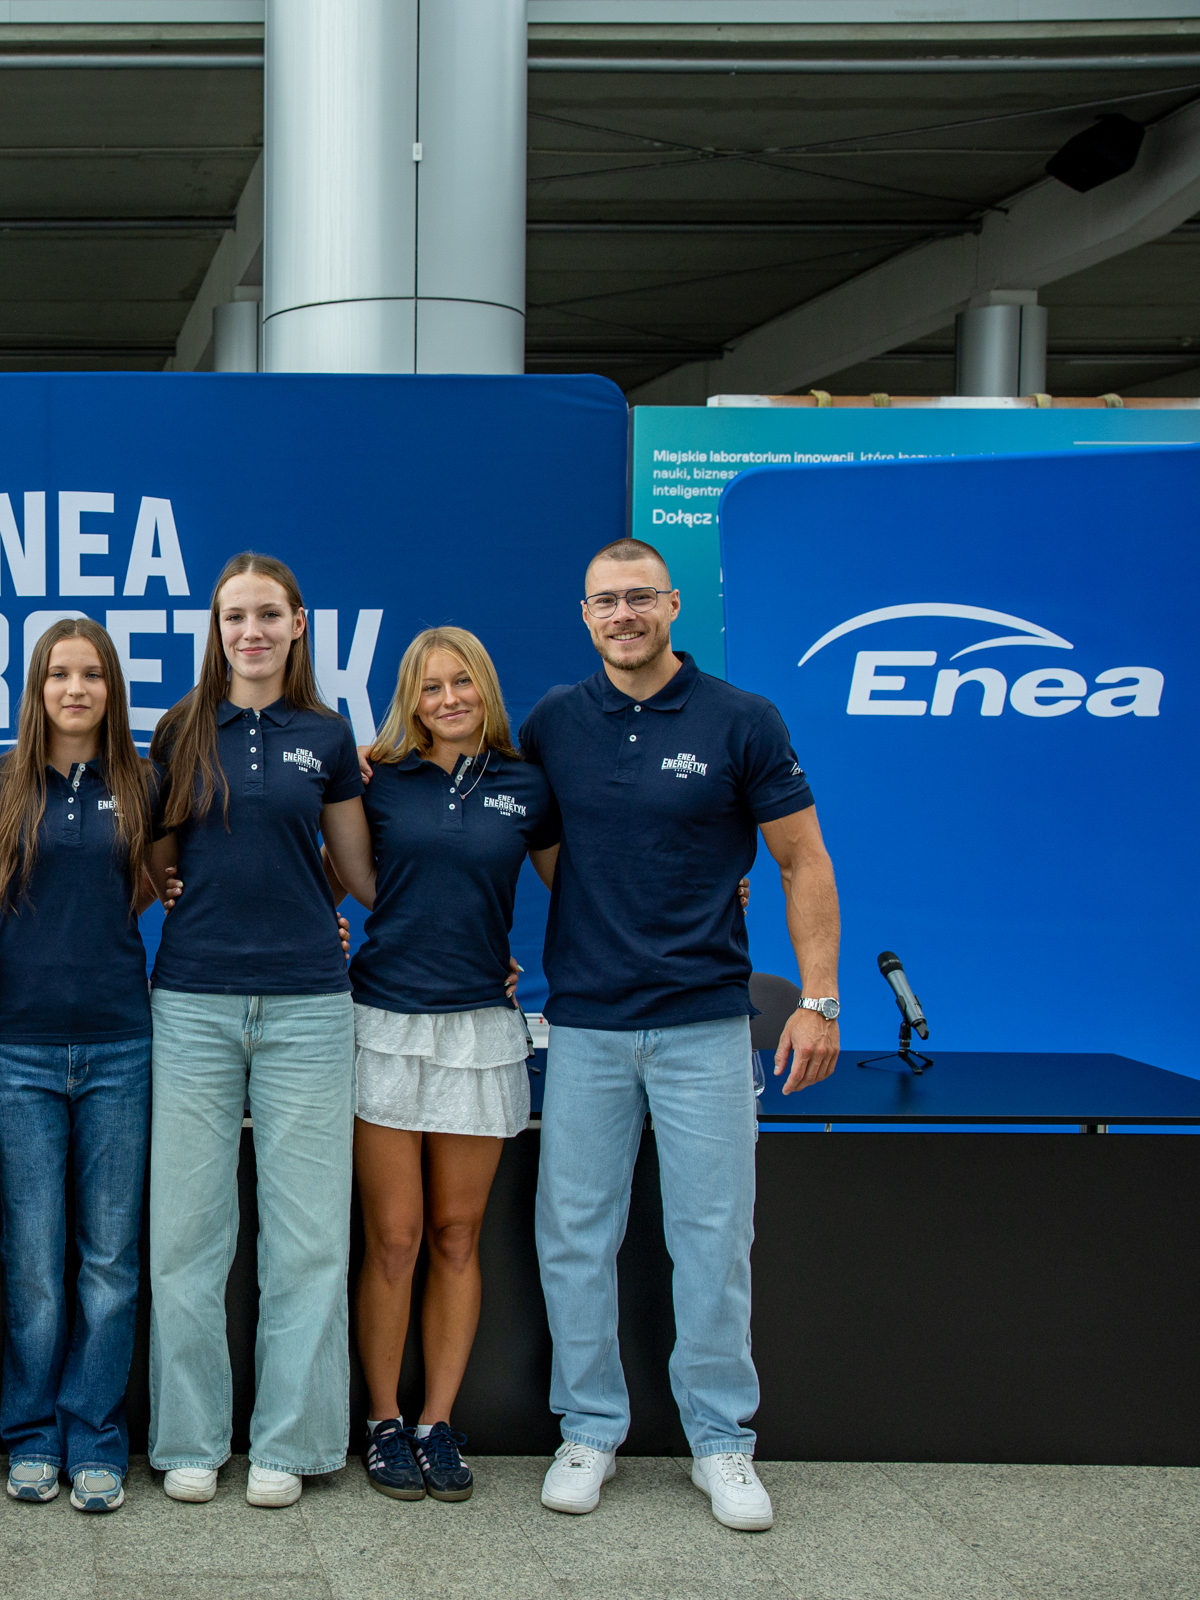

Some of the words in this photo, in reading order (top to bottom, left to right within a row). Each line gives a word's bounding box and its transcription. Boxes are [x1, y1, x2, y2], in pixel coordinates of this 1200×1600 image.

[653, 450, 707, 465] Miejskie
[709, 451, 792, 463] laboratorium
[653, 468, 691, 480] nauki,
[652, 509, 712, 528] Dołącz
[846, 651, 1164, 717] Enea
[296, 748, 313, 757] ENEA
[677, 753, 696, 761] ENEA
[283, 751, 322, 772] ENERGETYK
[661, 758, 708, 775] ENERGETYK
[484, 796, 526, 815] ENERGETYK
[498, 794, 515, 804] ENEA
